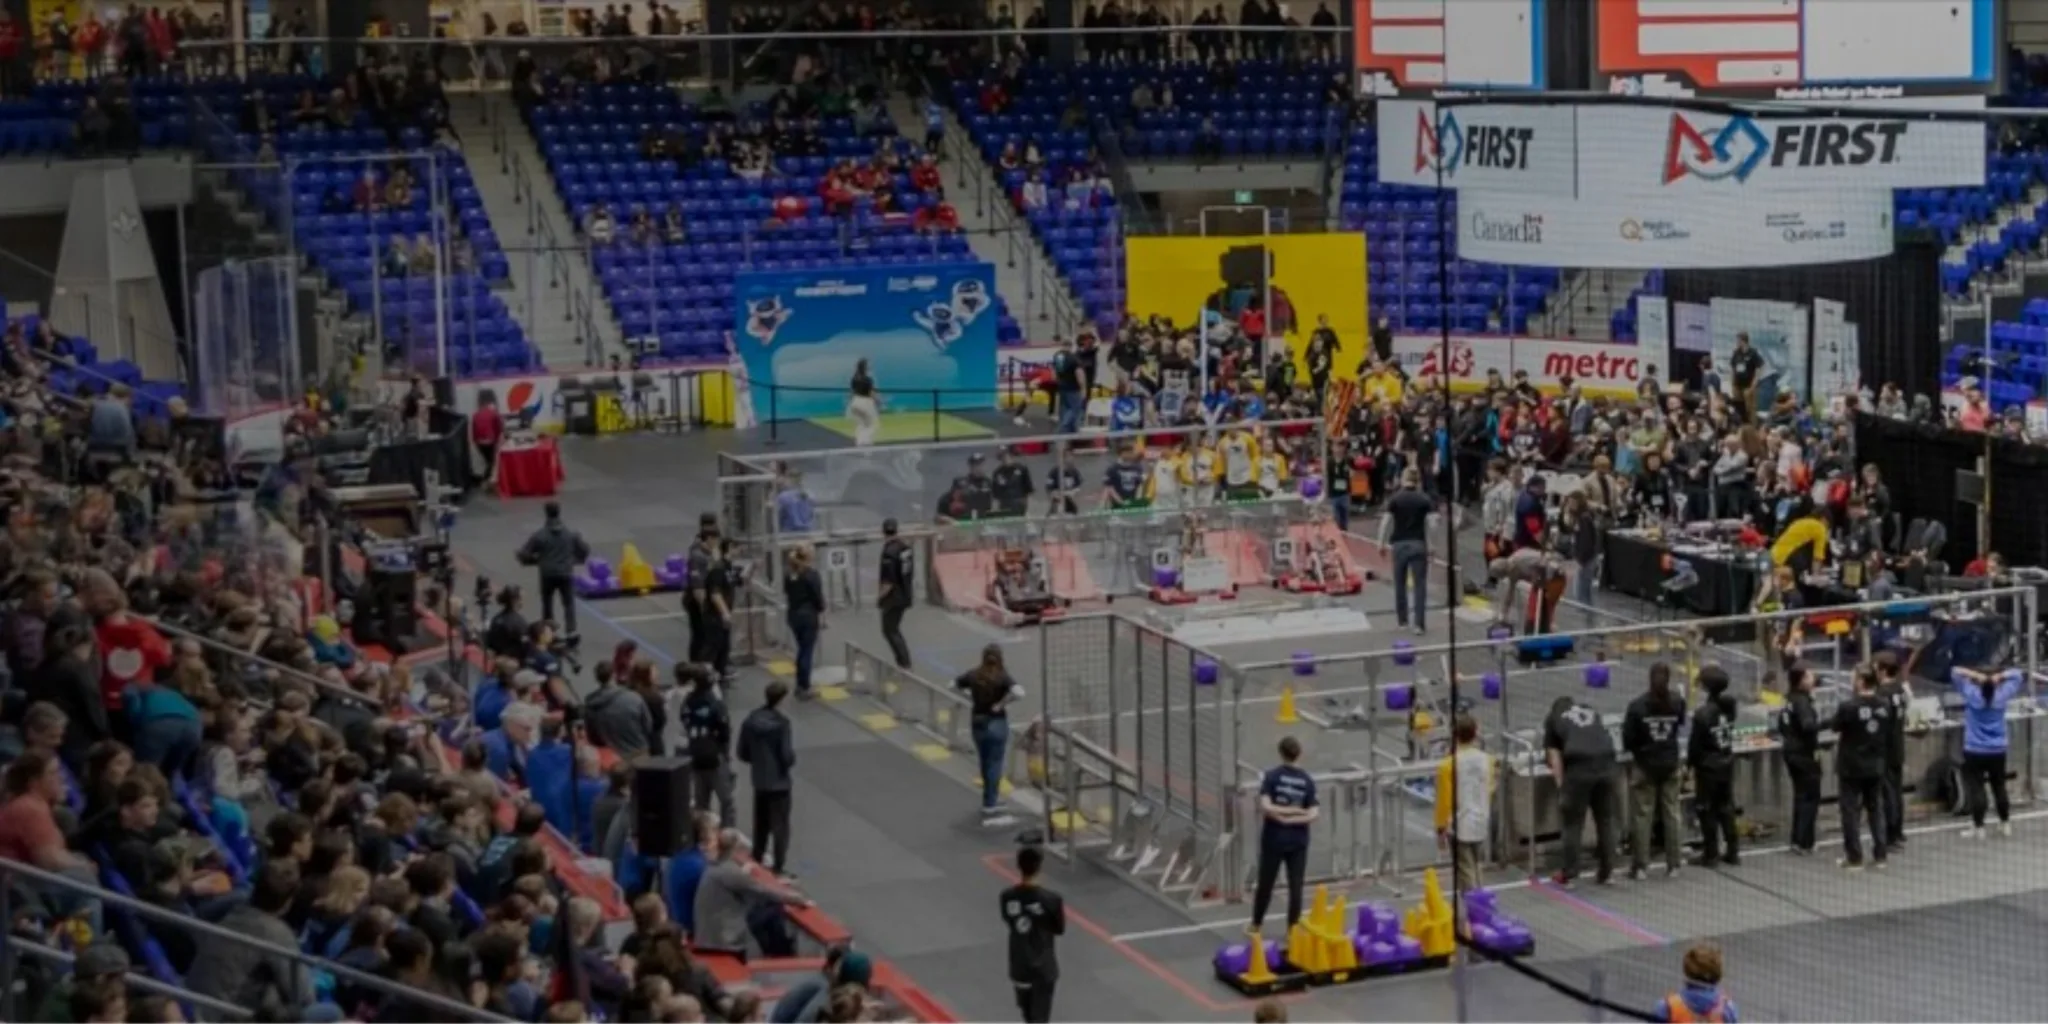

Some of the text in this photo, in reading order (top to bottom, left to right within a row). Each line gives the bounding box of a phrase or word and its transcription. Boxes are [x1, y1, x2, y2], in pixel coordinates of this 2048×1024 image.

[1465, 126, 1534, 168] FIRST
[1771, 123, 1907, 167] FIRST
[1472, 211, 1542, 243] Canada
